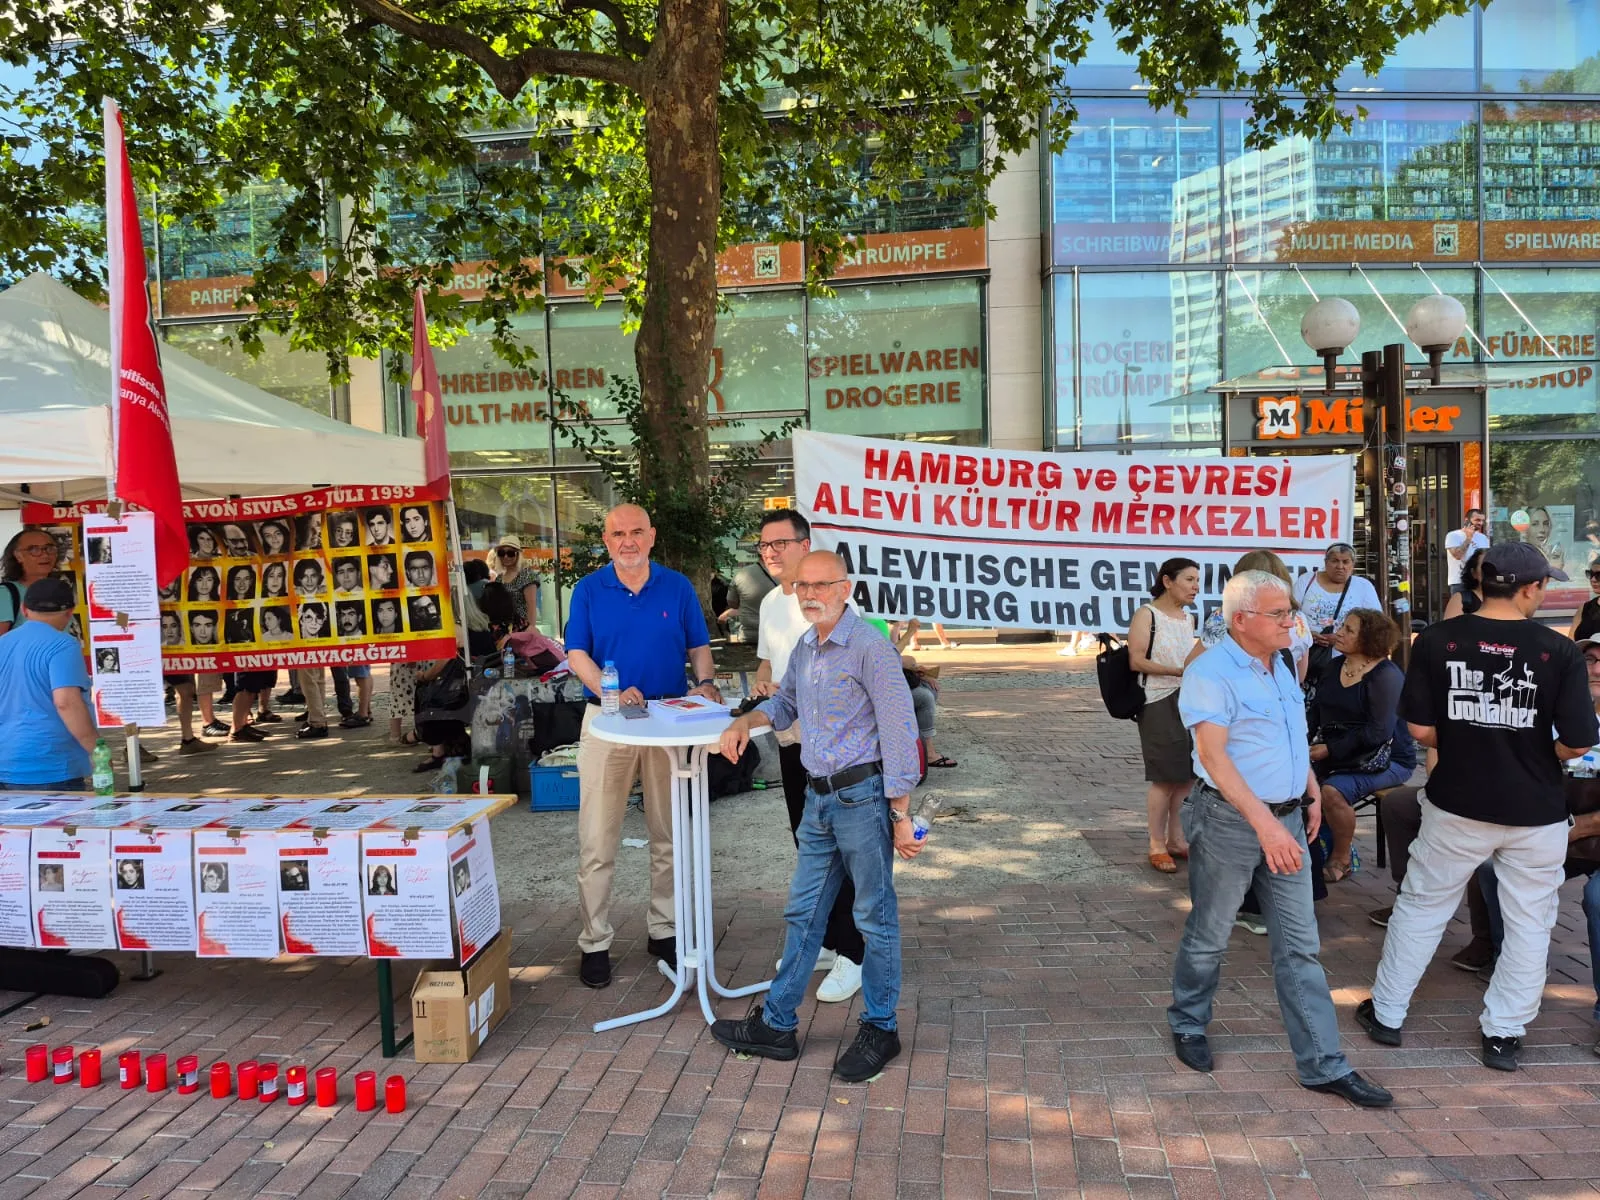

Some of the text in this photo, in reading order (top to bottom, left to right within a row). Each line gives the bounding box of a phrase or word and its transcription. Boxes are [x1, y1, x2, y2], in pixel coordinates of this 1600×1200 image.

[1291, 233, 1414, 250] MULTI-MEDIA
[808, 346, 979, 379] SPIELWAREN
[826, 381, 961, 410] DROGERIE
[865, 448, 1292, 501] HAMBURG ve ÇEVRESİ
[196, 500, 238, 518] VON
[242, 499, 298, 516] SIVAS
[305, 494, 323, 508] 2.
[371, 486, 416, 501] 1993
[813, 482, 1340, 539] ALEVİ KÜLTÜR MERKEZLERİ
[835, 541, 1080, 590] ALEVITISCHE
[853, 580, 1019, 623] AMBURG
[1030, 595, 1101, 627] und
[235, 644, 407, 668] UNUTMAYACAĞIZ!
[1446, 661, 1484, 691] The
[1447, 689, 1538, 728] Godfather
